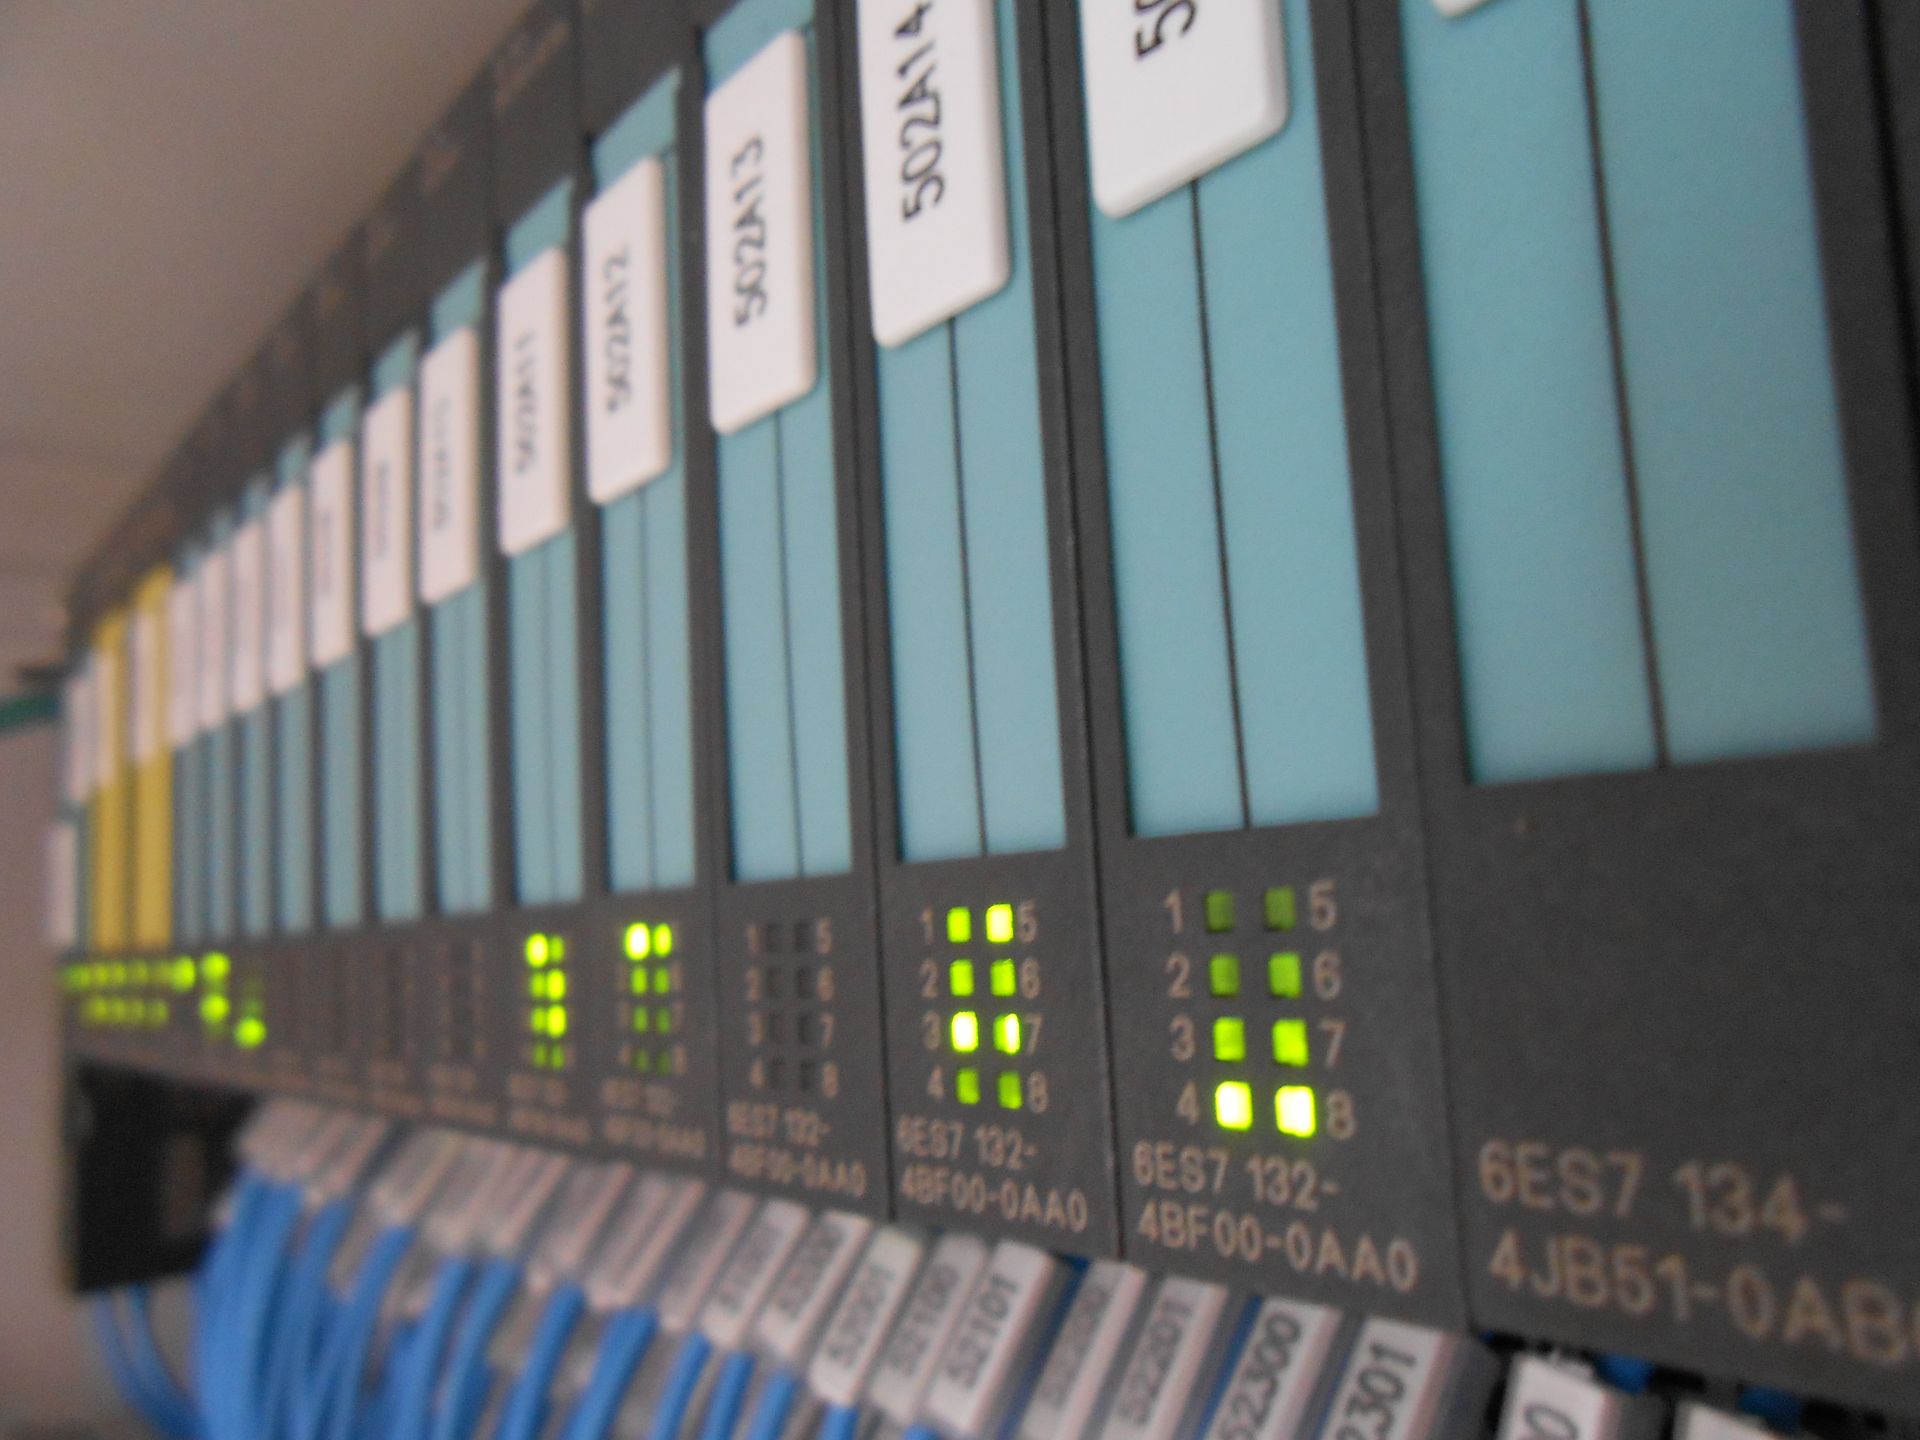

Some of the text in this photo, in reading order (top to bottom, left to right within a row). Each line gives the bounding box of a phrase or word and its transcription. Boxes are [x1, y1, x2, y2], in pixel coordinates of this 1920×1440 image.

[1135, 0, 1197, 58] 5
[894, 1, 945, 223] 502A14
[731, 134, 767, 327] 502A13
[921, 907, 934, 944] 1
[1020, 900, 1037, 943] 5
[1164, 889, 1183, 933] 1
[1308, 880, 1337, 931] 5
[920, 959, 938, 999] 2
[1166, 951, 1191, 998] 2
[1314, 950, 1342, 998] 6
[923, 1011, 941, 1050] 3
[1023, 1012, 1042, 1055] 7
[1169, 1016, 1195, 1061] 3
[1319, 1019, 1346, 1067] 7
[928, 1066, 944, 1099] 4
[1177, 1082, 1199, 1125] 4
[1326, 1091, 1355, 1140] 8
[1133, 1140, 1340, 1211] 6ES7 132-
[1479, 1139, 1848, 1246] 6ES7 134-
[1138, 1201, 1418, 1292] 4BF00-0AA0
[1490, 1229, 1920, 1364] 4JB51-0AB
